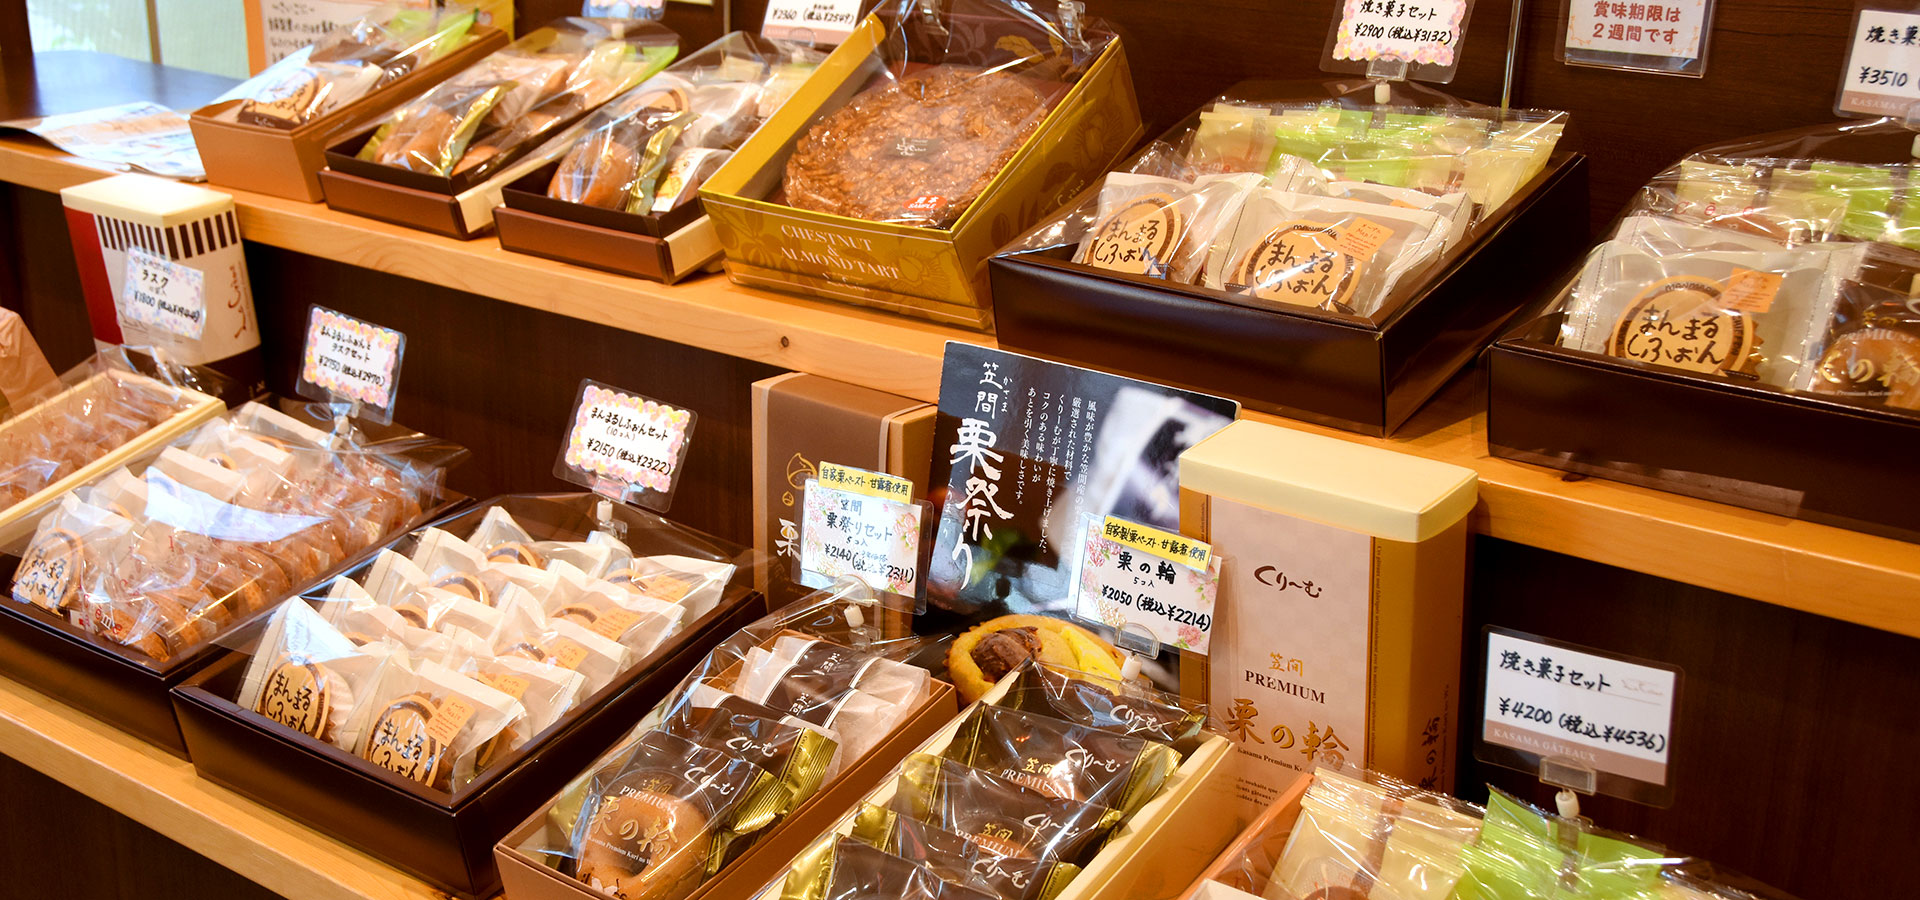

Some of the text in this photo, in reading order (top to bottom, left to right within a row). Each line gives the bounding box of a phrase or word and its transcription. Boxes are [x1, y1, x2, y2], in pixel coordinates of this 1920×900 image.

[1360, 0, 1437, 20] 焼き菓子セット
[1594, 1, 1681, 22] 賞味期限は
[1355, 23, 1453, 45] ¥2900 (税込¥3132)
[1592, 23, 1678, 44] 2週間です
[1865, 26, 1920, 46] 焼き菓
[1859, 66, 1908, 87] ¥3510
[781, 224, 871, 251] CHESTNUT
[1106, 219, 1160, 243] まんまる
[781, 247, 899, 280] ALMOND TART
[827, 244, 839, 257] &
[1268, 240, 1334, 274] まんまる
[142, 269, 169, 289] ラスク
[1640, 304, 1720, 340] まんまる
[591, 407, 668, 441] まんまるしふぉんセット
[1031, 392, 1051, 483] コクのある味わいが
[1062, 397, 1083, 481] 厳選された材料で
[587, 438, 671, 475] ¥2150 (税込¥2322)
[1015, 387, 1037, 505] あとを引く美味しさです。
[950, 418, 1015, 591] 栗祭り
[826, 511, 893, 541] 栗祭りセット
[1102, 584, 1211, 632] ¥2050 (税込¥2214)
[1268, 651, 1304, 678] 笠間
[1500, 650, 1611, 692] 焼き菓子セット
[273, 670, 313, 711] まんまる
[1245, 669, 1325, 704] PREMIUM
[381, 718, 424, 760] まんまる
[1225, 698, 1349, 771] 栗の輪
[1493, 727, 1540, 749] KASAMA
[1499, 697, 1666, 753] ¥4200 (税込¥4536)
[619, 785, 679, 815] PREMIUM
